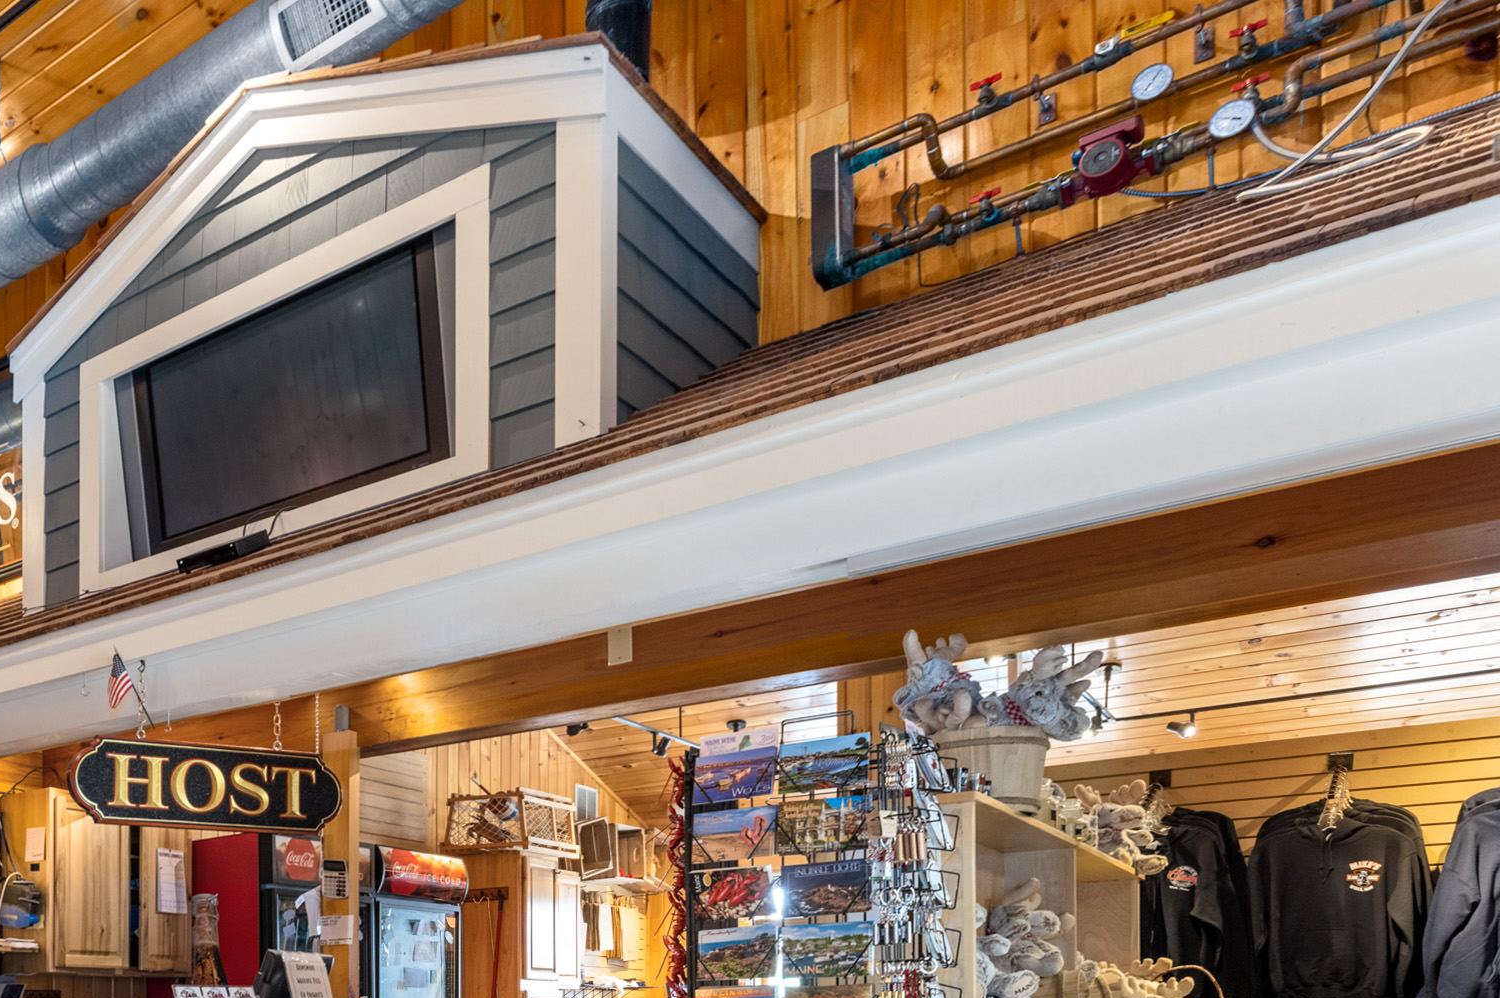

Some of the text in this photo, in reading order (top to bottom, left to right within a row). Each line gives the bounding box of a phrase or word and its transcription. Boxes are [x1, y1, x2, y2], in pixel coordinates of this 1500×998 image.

[105, 752, 317, 820] HOST
[1348, 860, 1382, 871] MIKE'S
[424, 874, 461, 886] ICE COLD
